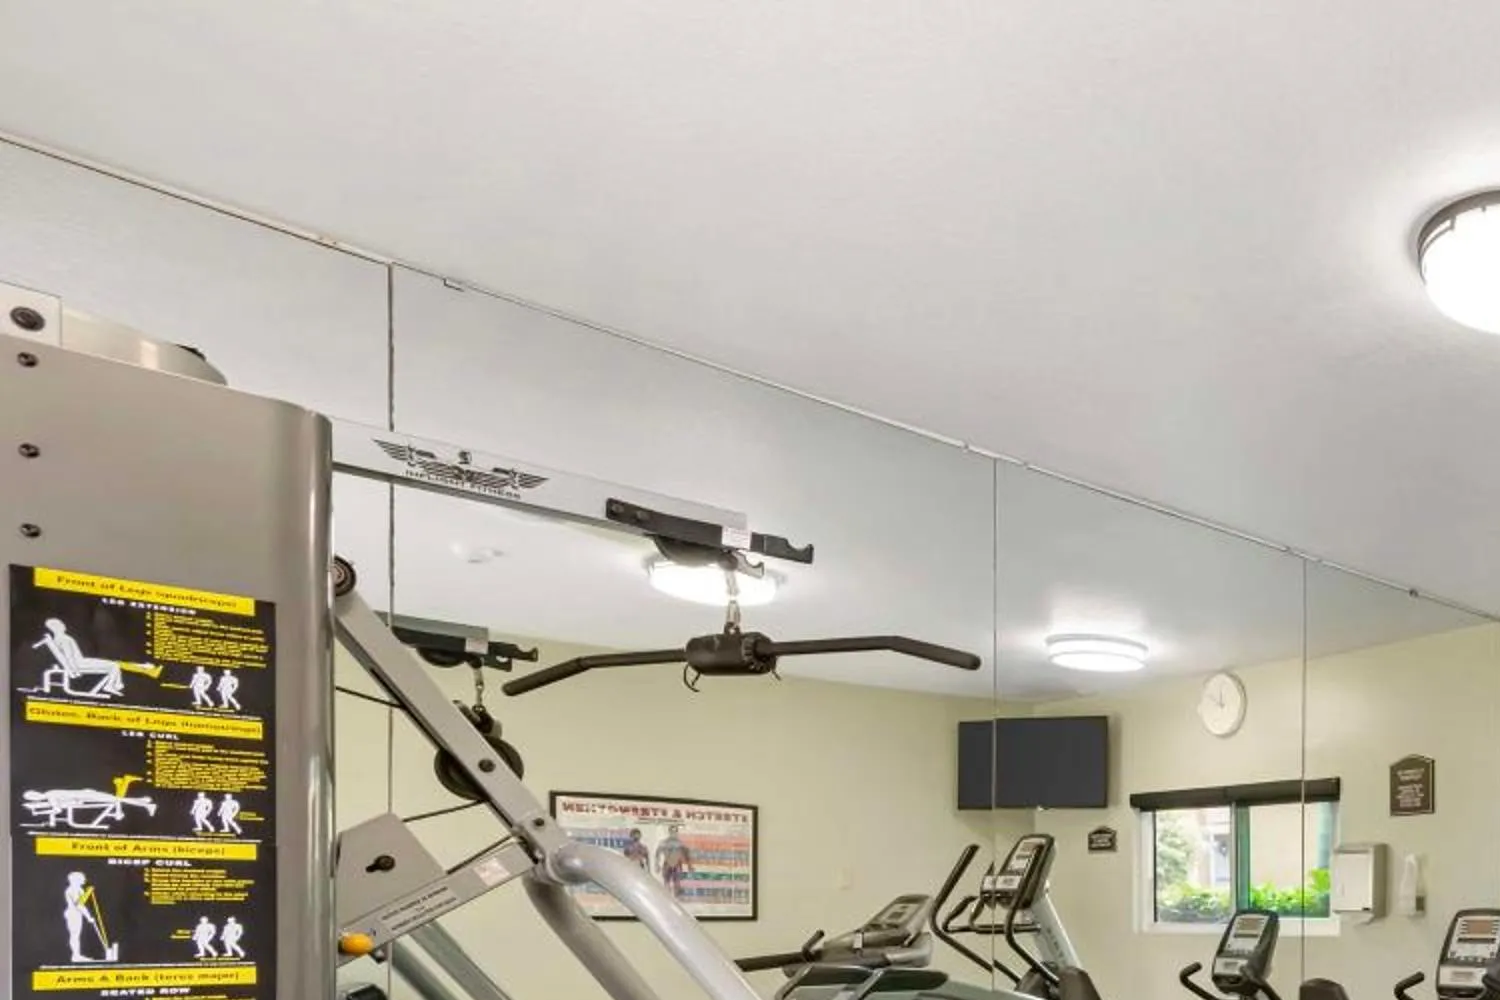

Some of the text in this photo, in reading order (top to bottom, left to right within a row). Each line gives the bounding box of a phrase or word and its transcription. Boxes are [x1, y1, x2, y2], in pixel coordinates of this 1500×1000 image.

[71, 841, 110, 852] Front
[113, 843, 129, 852] of
[132, 844, 169, 854] Arms
[107, 858, 193, 867] BICEP CURL
[56, 974, 95, 984] Arms
[114, 973, 150, 982] Back
[100, 987, 192, 998] SEATED ROW
